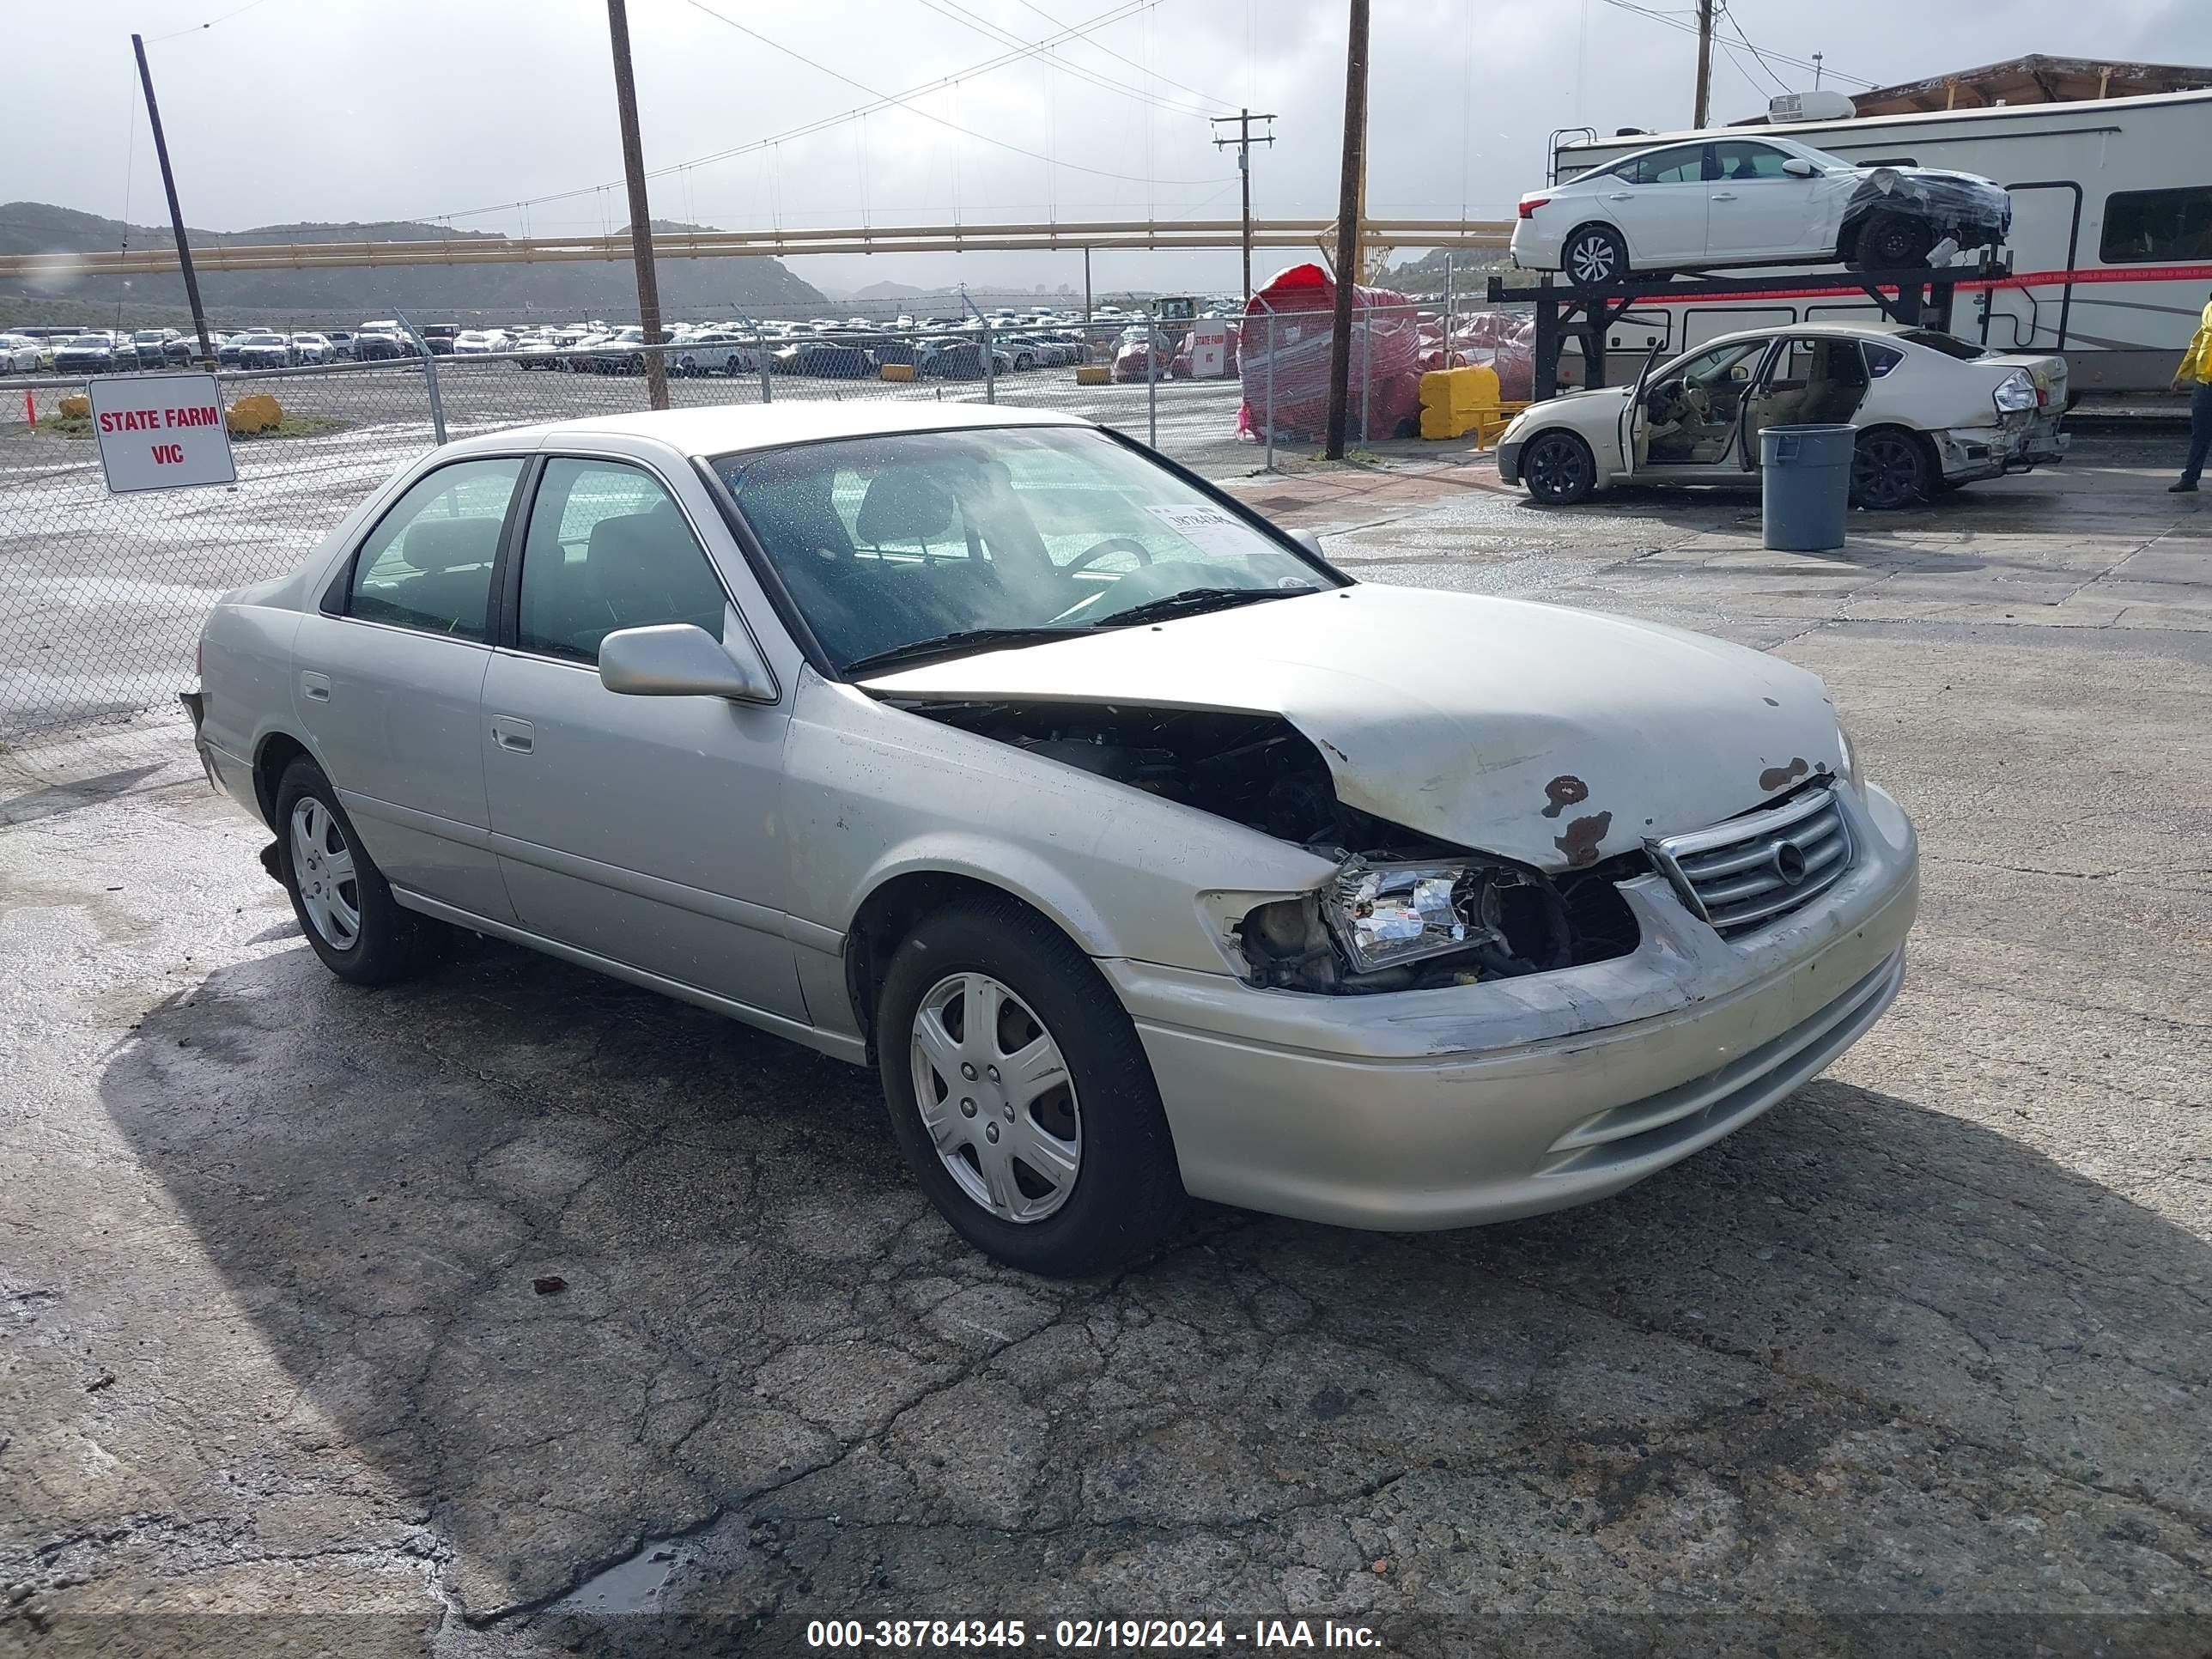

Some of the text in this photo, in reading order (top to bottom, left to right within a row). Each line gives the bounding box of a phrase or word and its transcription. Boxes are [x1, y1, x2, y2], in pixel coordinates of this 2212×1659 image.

[100, 406, 219, 432] STATE FARM
[151, 444, 184, 465] VIC
